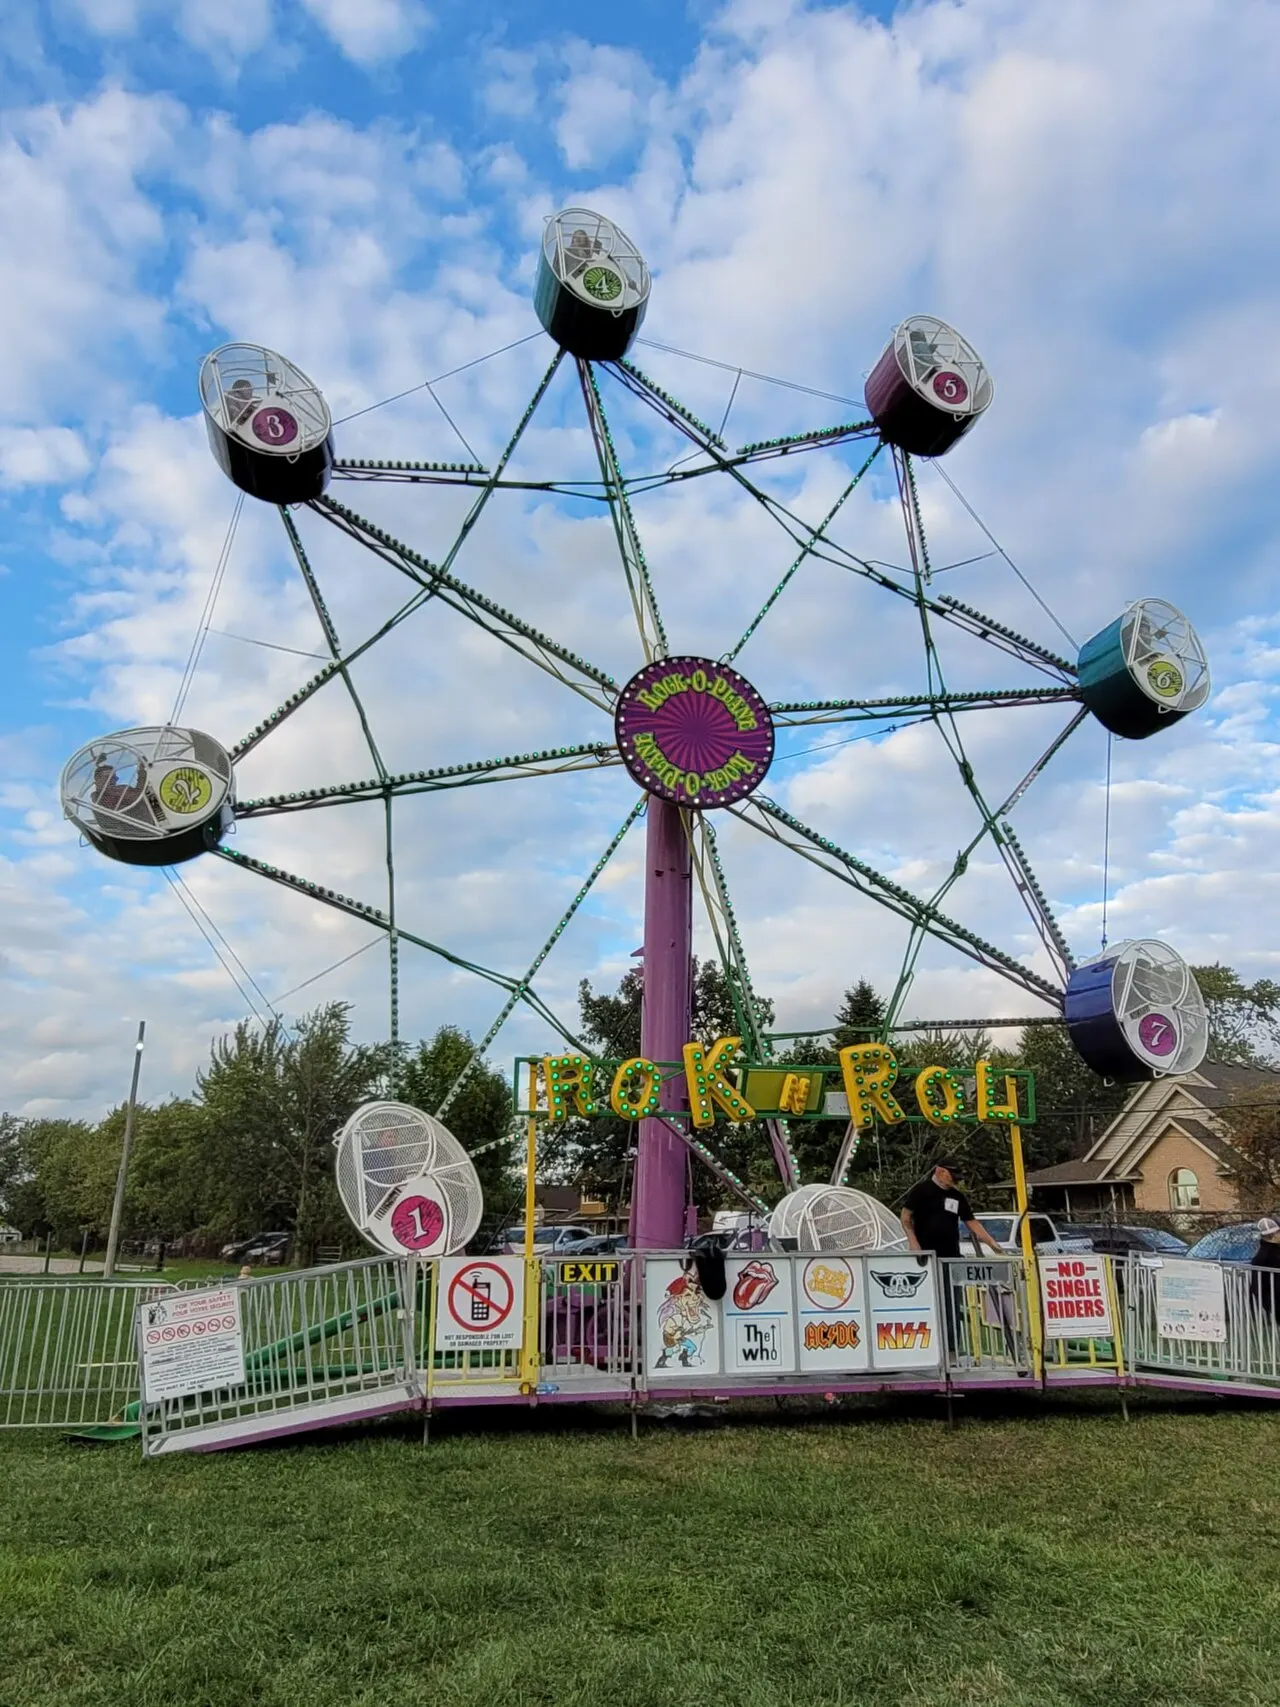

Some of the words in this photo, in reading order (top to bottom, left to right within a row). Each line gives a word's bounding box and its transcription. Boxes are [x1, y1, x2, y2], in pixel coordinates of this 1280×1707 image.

[594, 274, 609, 294] 4
[944, 379, 957, 398] 5
[266, 415, 284, 437] 3
[1157, 670, 1174, 690] 6
[171, 778, 201, 806] 2
[1151, 1021, 1168, 1047] 7
[543, 1037, 756, 1128] ROK
[407, 1205, 430, 1242] 1
[563, 1263, 616, 1282] EXIT
[967, 1266, 992, 1281] EXIT
[1058, 1261, 1085, 1277] NO
[1046, 1279, 1101, 1298] SINGLE
[1047, 1299, 1105, 1319] RIDERS
[744, 1324, 770, 1343] The
[876, 1322, 931, 1349] KISS
